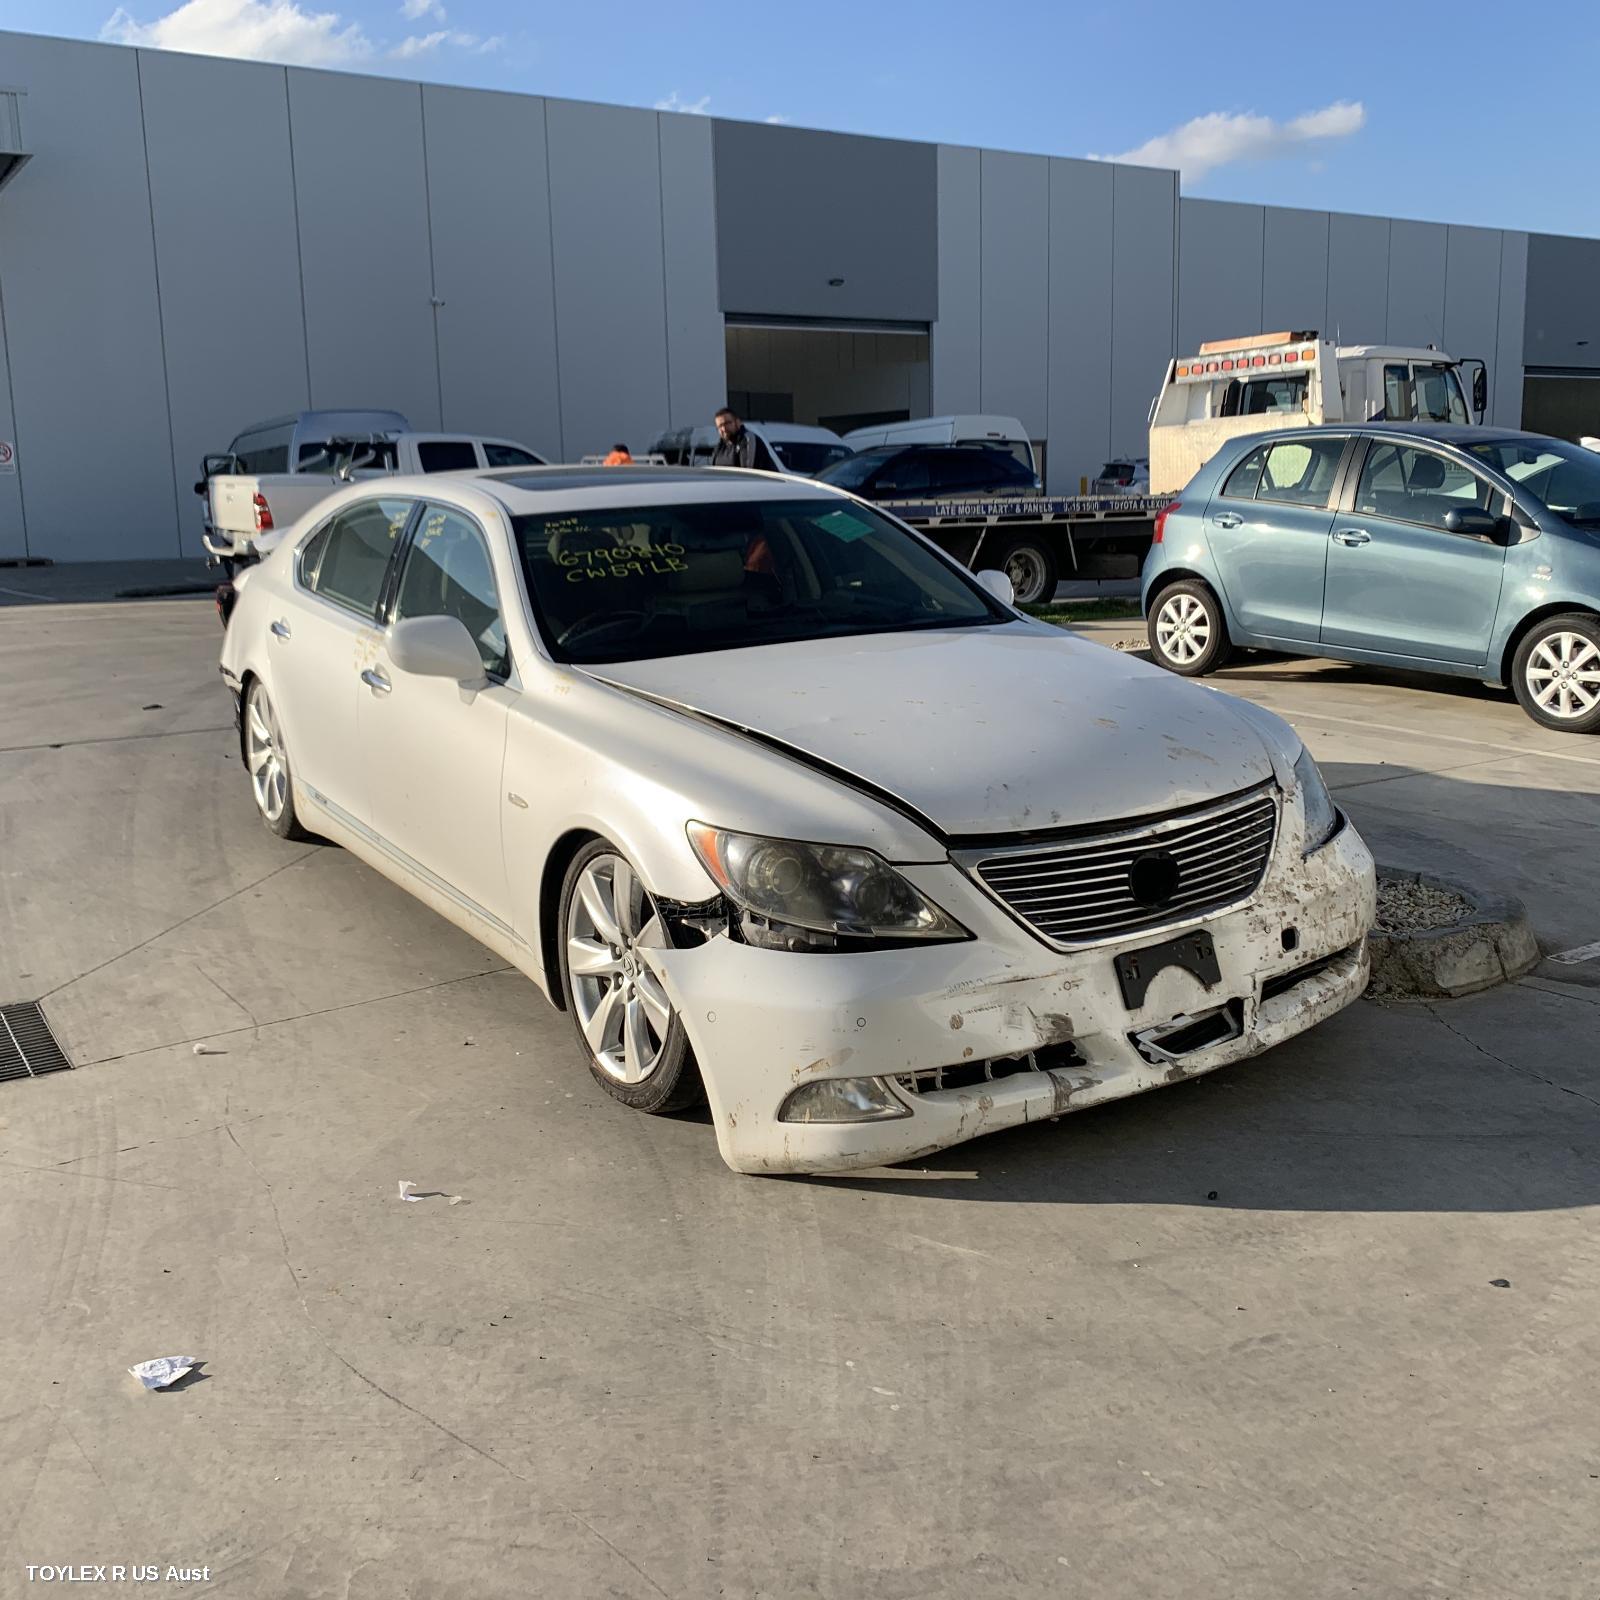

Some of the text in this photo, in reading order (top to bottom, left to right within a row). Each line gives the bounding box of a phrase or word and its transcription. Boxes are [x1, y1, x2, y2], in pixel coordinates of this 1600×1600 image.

[935, 504, 956, 516] LATE
[958, 503, 986, 516] MODEL
[1015, 503, 1021, 514] &
[1023, 501, 1053, 513] PANELS
[1110, 500, 1138, 511] TOYOTA
